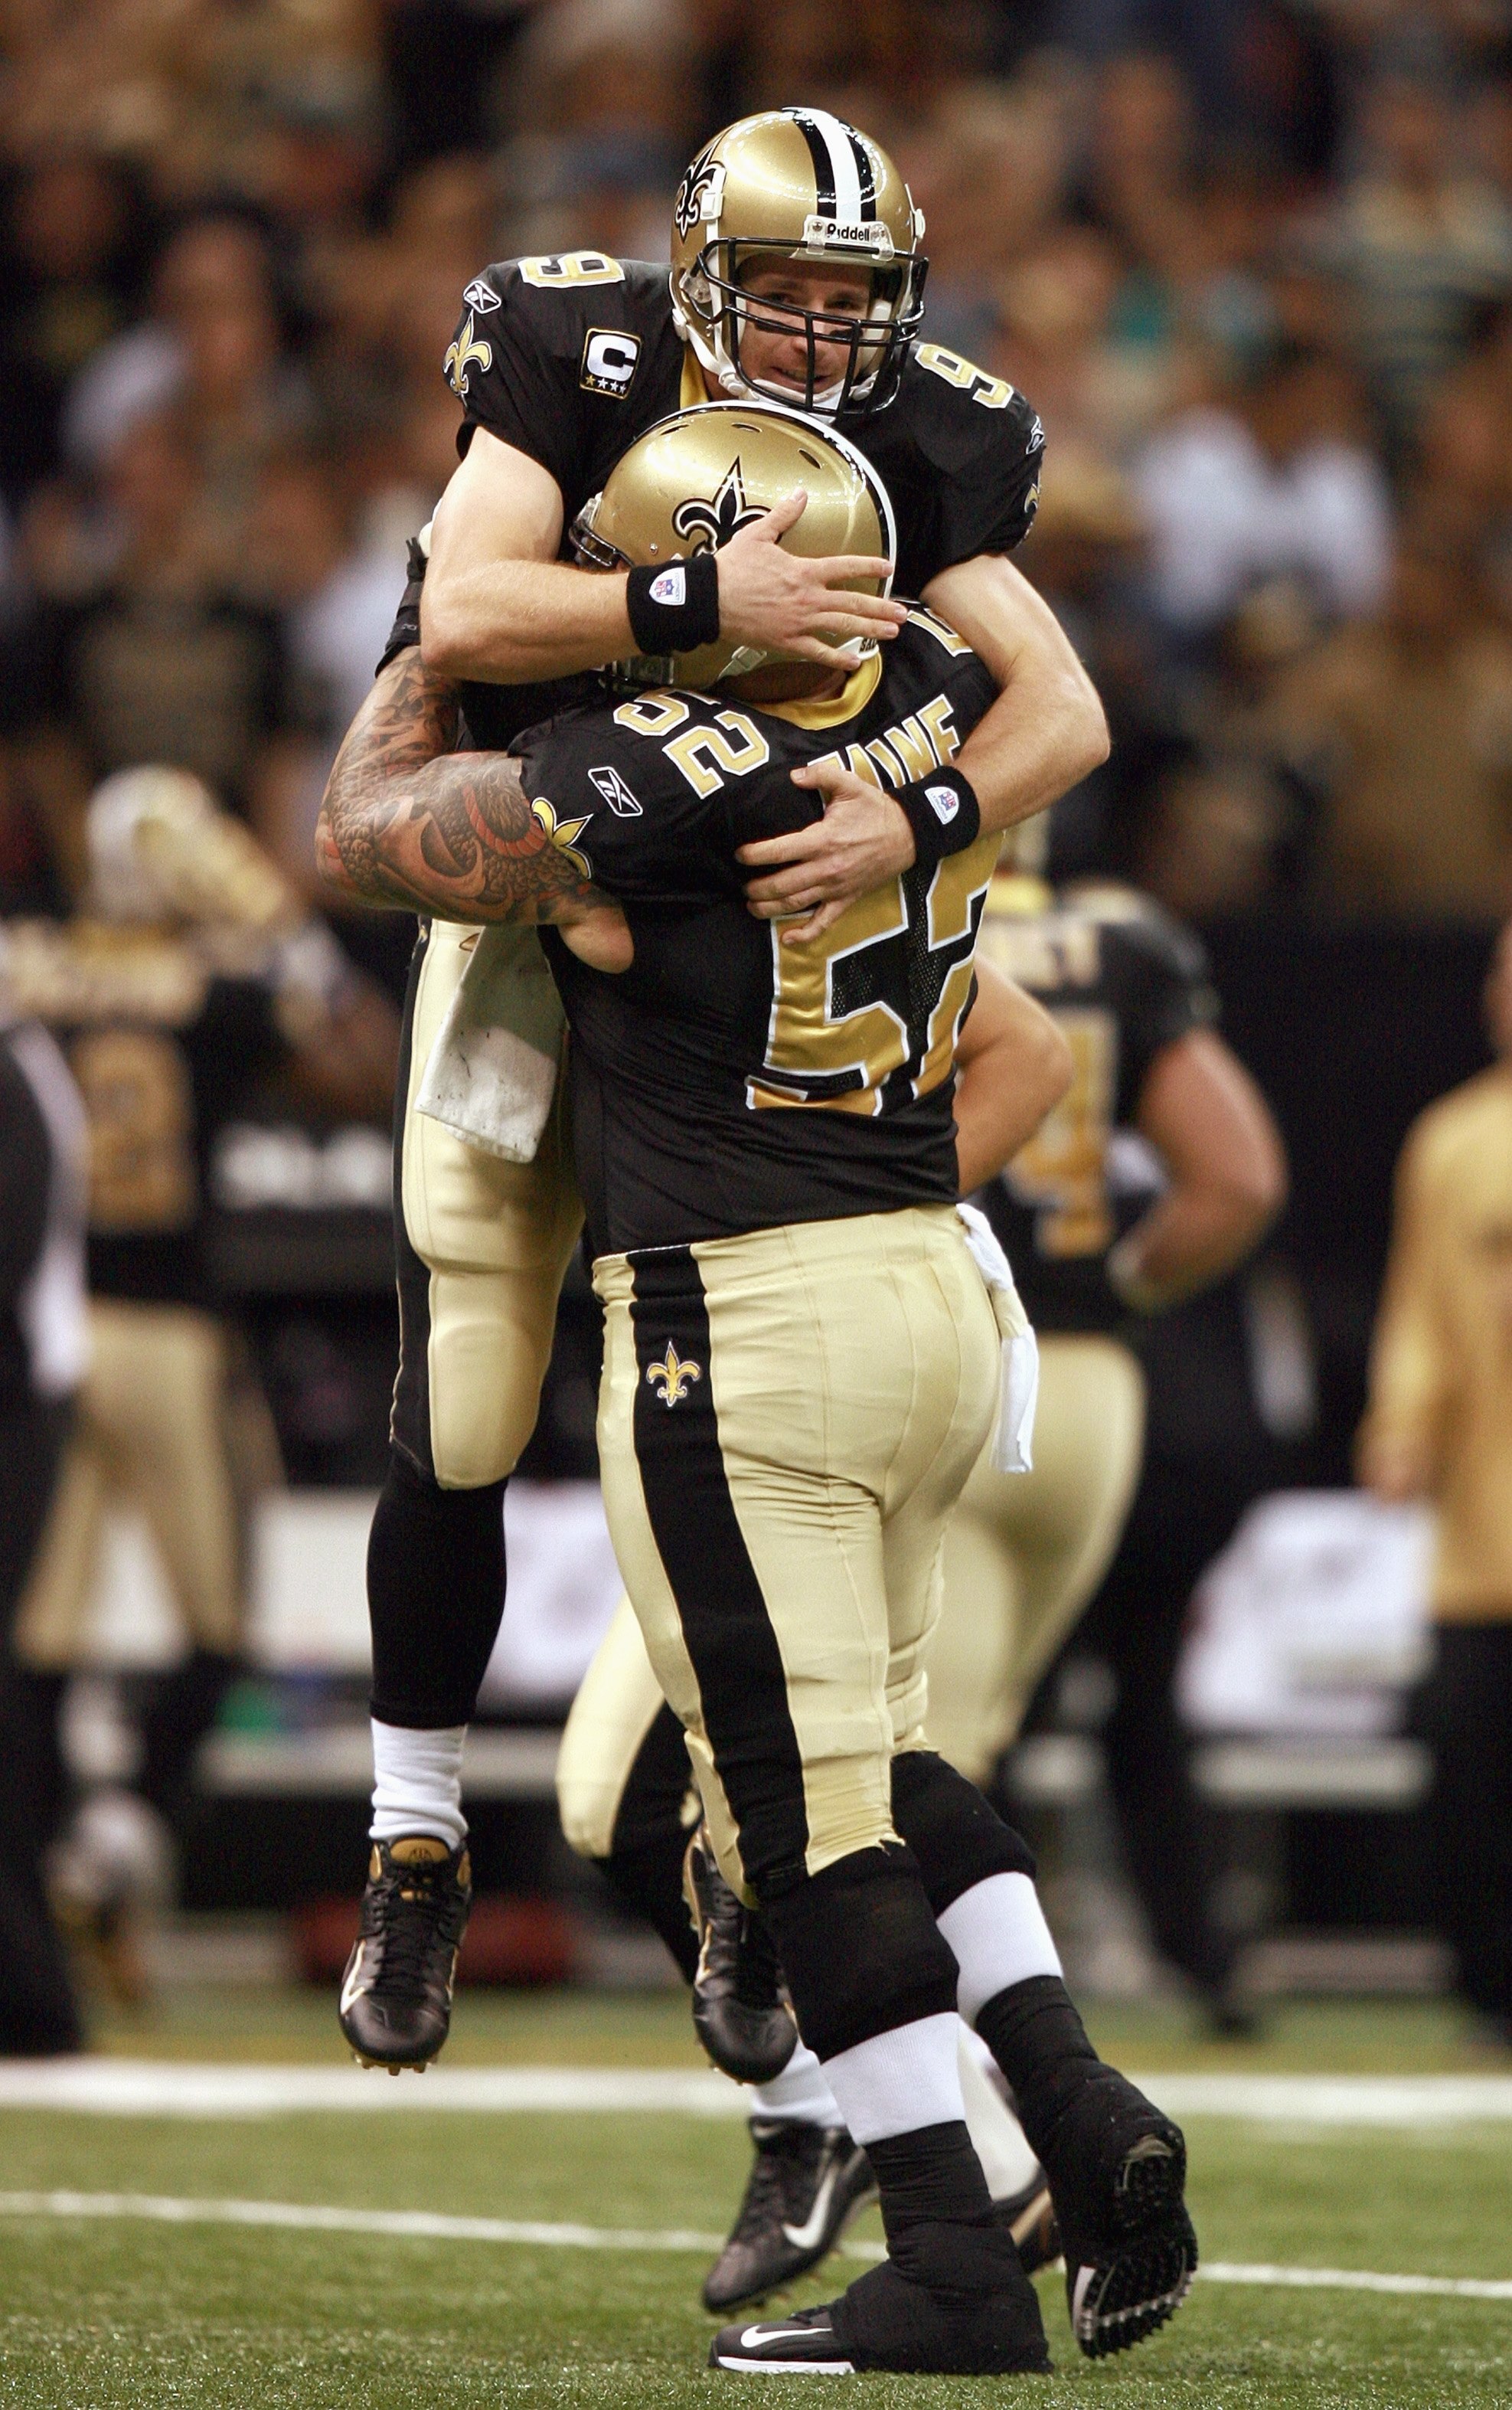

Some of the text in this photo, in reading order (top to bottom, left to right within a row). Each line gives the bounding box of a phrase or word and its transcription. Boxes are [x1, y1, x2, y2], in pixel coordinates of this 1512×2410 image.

[518, 250, 625, 289] 9
[586, 334, 638, 382] C
[914, 344, 1014, 408] 9
[613, 688, 769, 800] 52
